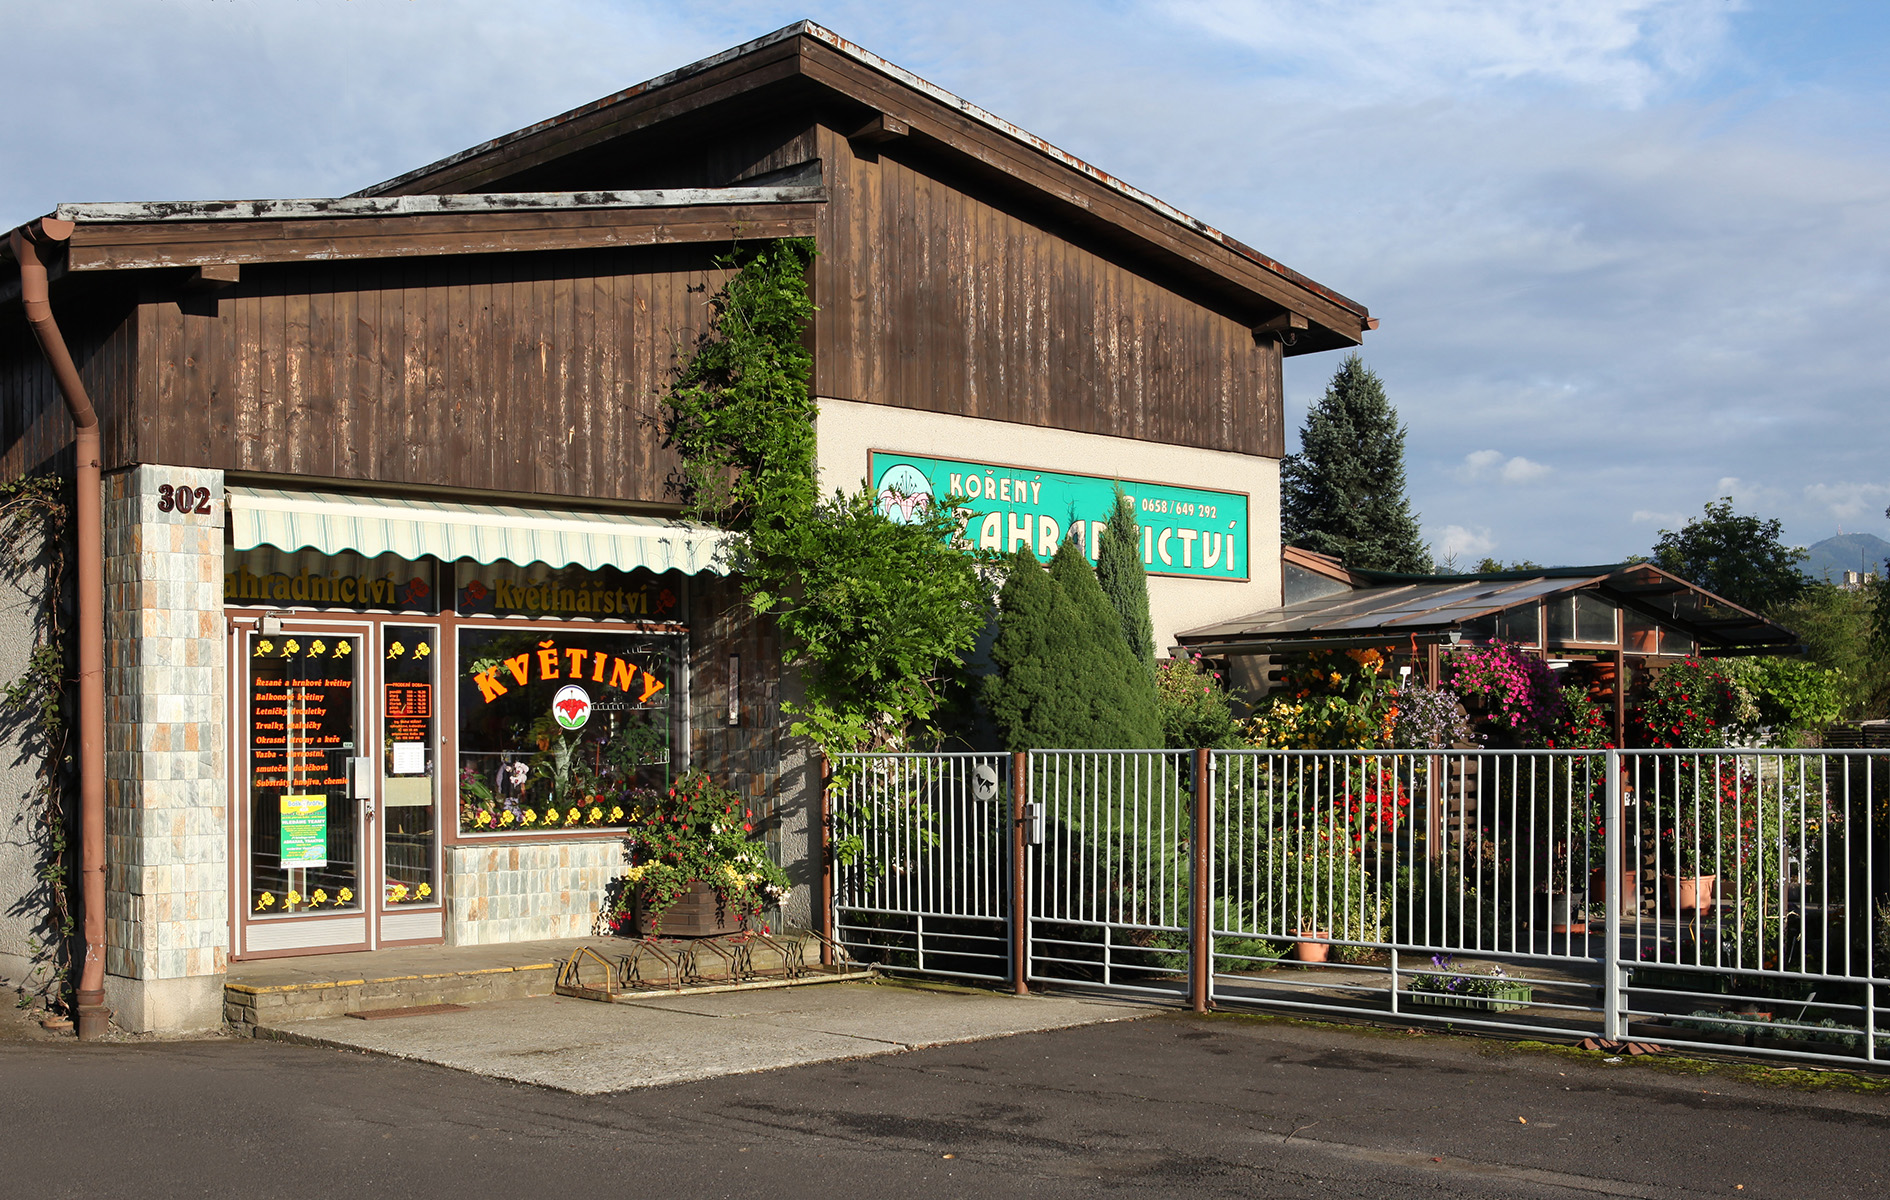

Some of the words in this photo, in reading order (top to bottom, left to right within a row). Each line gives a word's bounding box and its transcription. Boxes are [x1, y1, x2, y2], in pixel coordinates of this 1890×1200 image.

[949, 469, 1042, 505] KOŘENÝ
[157, 484, 212, 516] 302
[1198, 504, 1217, 519] 292
[494, 578, 648, 615] Květinářství
[473, 639, 665, 704] KVĚTINY
[255, 676, 282, 687] Řezané
[284, 679, 290, 687] a
[292, 678, 322, 687] hrnkové
[324, 678, 352, 688] květiny
[255, 692, 294, 701] Balkonové
[296, 693, 324, 702] květiny
[255, 736, 286, 744] Okrasné
[324, 735, 340, 743] keře
[255, 750, 276, 758] Vazba
[323, 777, 350, 785] chemie
